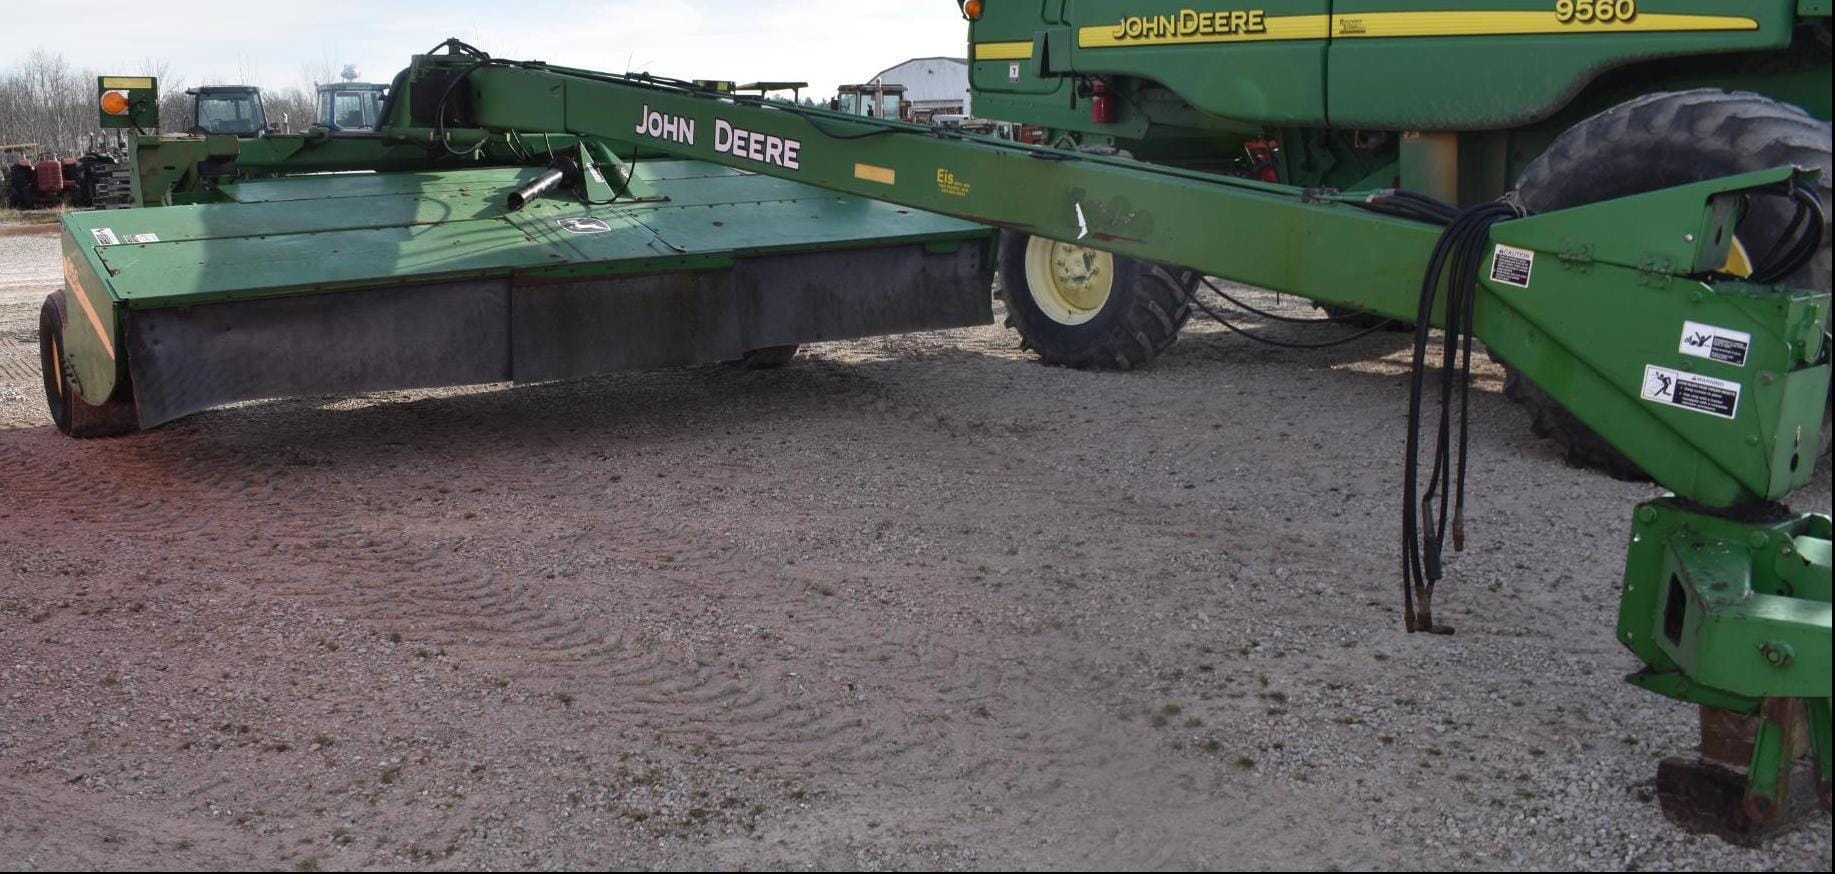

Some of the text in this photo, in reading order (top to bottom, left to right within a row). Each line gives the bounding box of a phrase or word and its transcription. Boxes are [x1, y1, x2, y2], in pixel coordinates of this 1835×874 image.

[1556, 0, 1635, 23] 9560
[1113, 9, 1266, 38] JOHN DEERE
[634, 103, 802, 170] JOHN DEERE
[936, 168, 954, 185] Eis
[1503, 247, 1531, 259] CAUTION
[1697, 376, 1725, 387] WARNING
